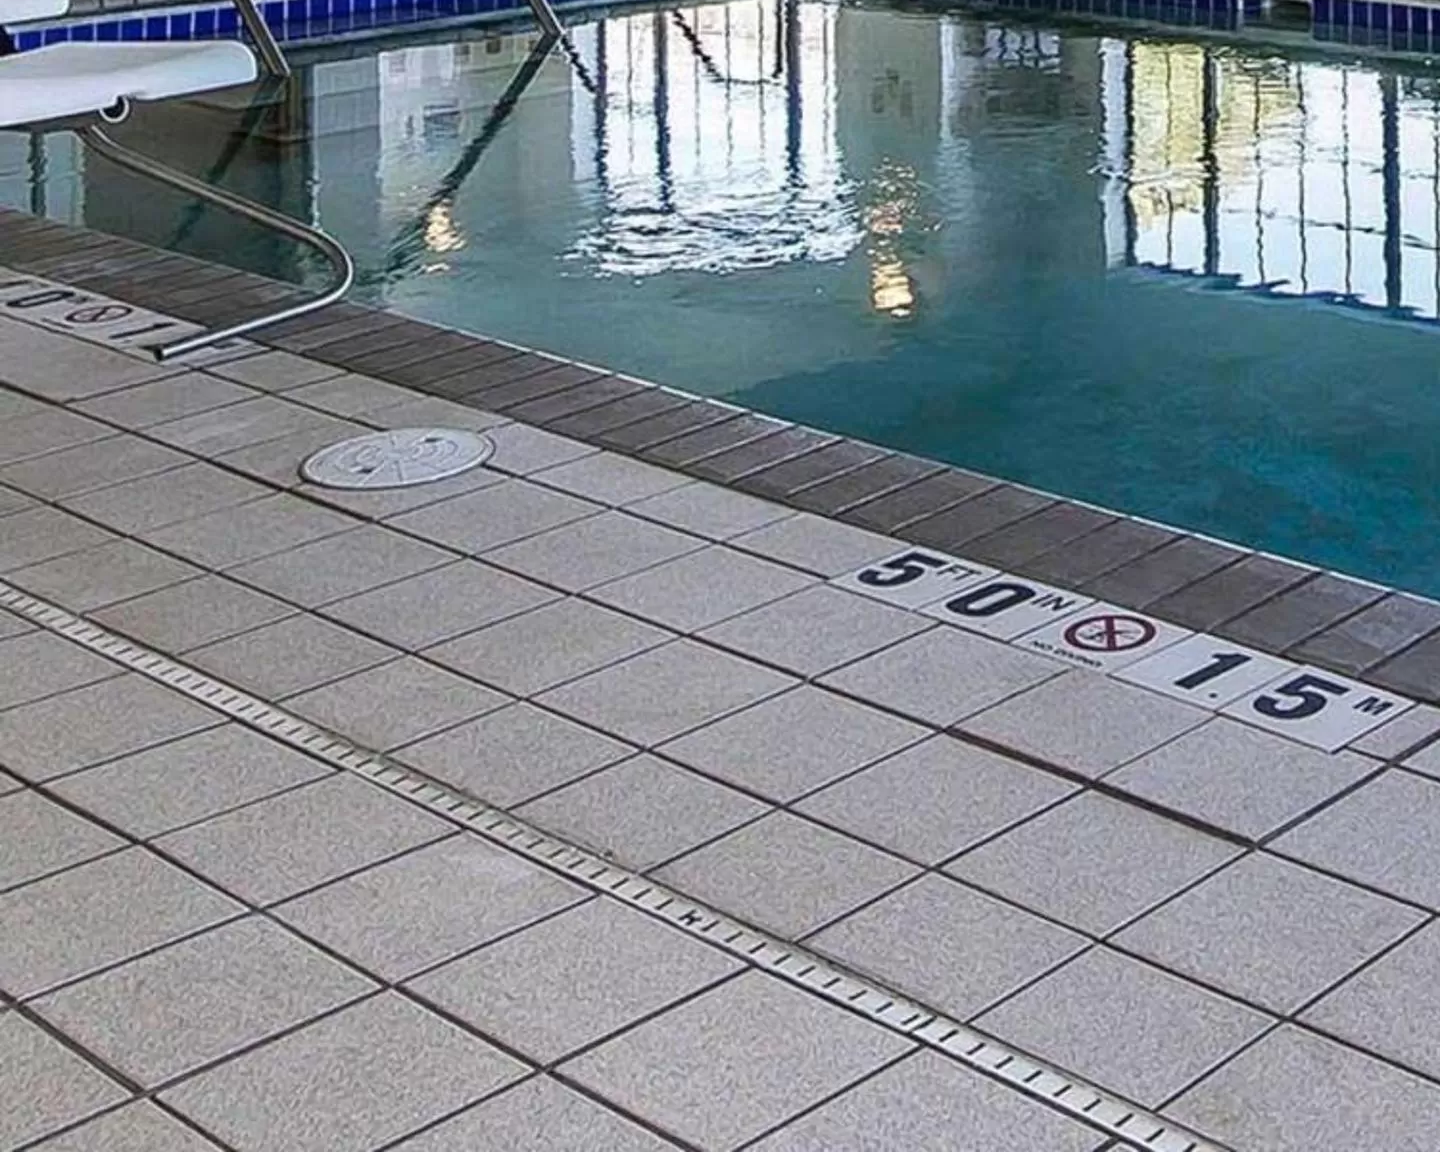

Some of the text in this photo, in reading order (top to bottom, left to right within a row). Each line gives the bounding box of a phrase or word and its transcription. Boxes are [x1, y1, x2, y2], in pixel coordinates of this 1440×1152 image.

[857, 551, 983, 586] 5 FT
[945, 583, 1076, 617] 0 IN
[1351, 696, 1394, 716] M
